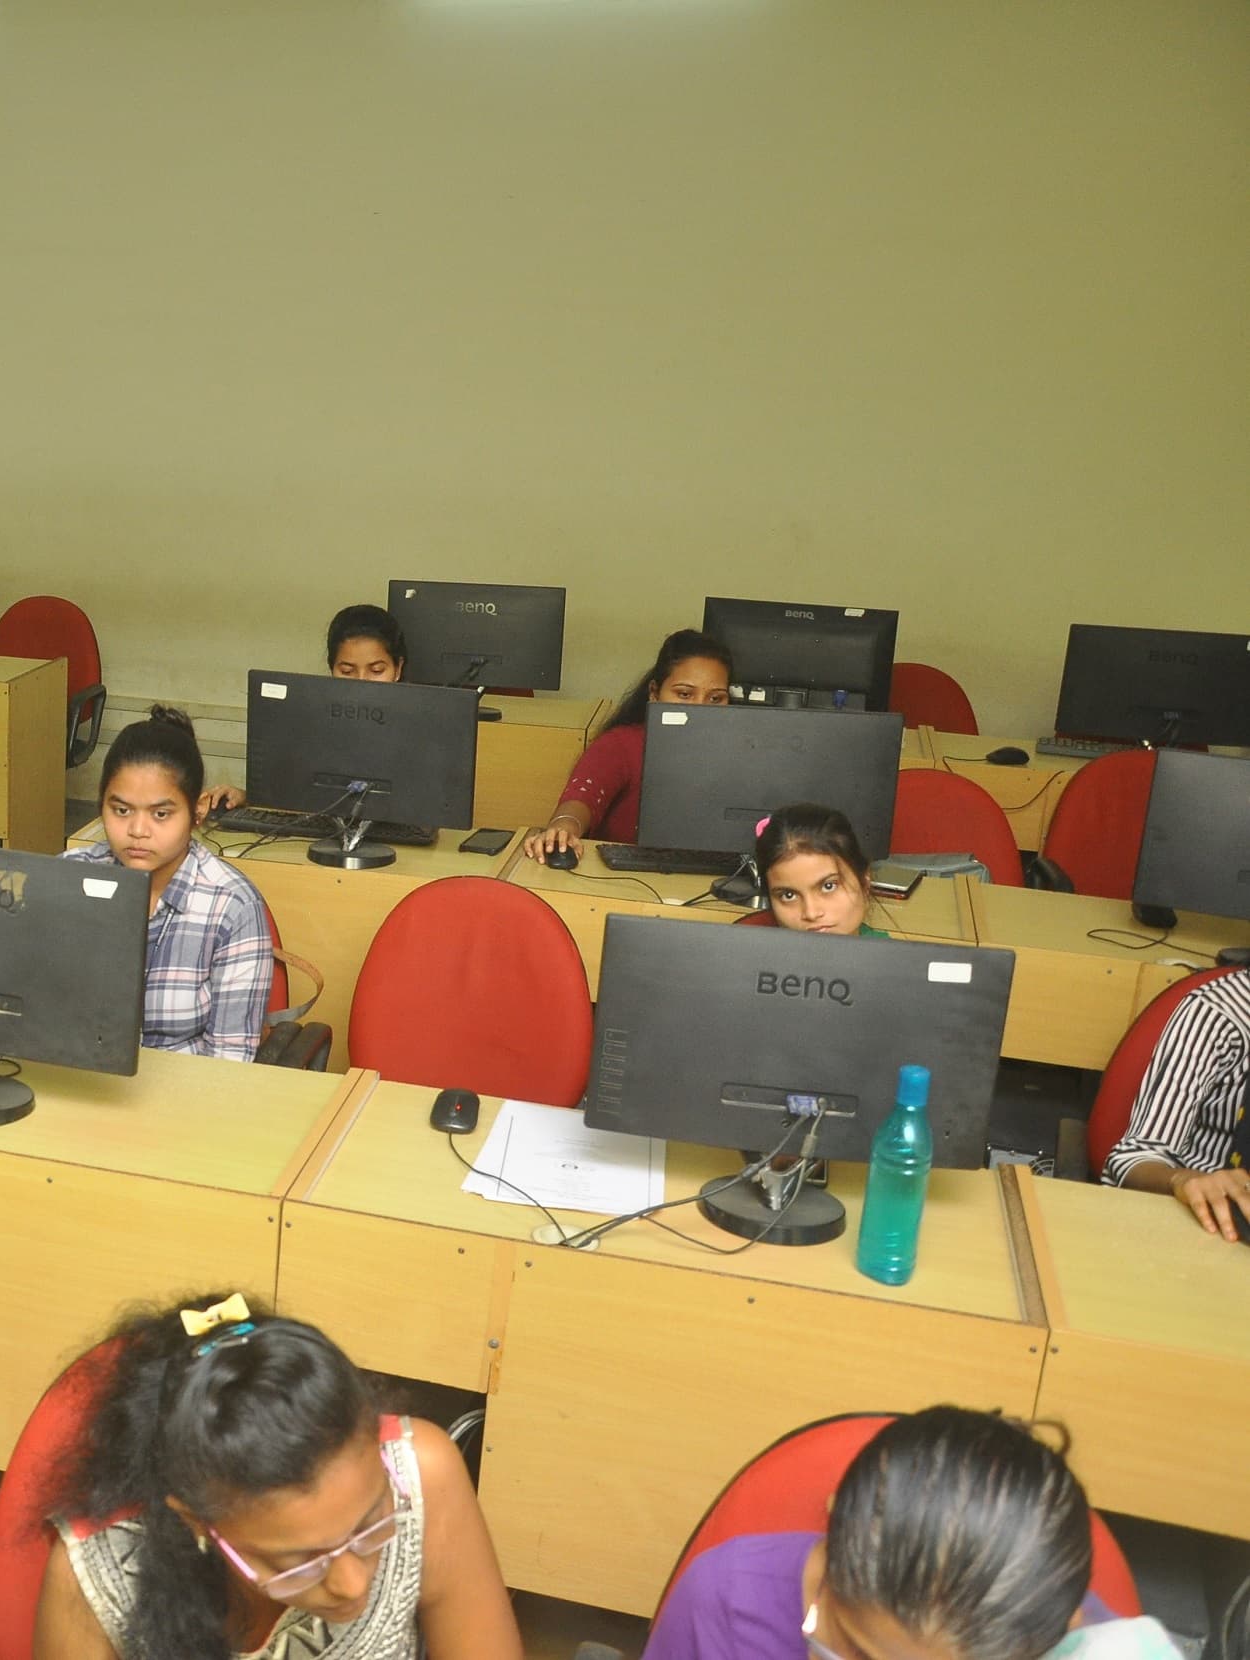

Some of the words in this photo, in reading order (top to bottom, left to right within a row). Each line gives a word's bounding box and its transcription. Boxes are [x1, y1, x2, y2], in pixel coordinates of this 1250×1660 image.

[456, 601, 497, 615] BenQ
[784, 609, 815, 620] BenQ
[330, 702, 385, 725] BenQ
[756, 971, 853, 1007] BenQ
